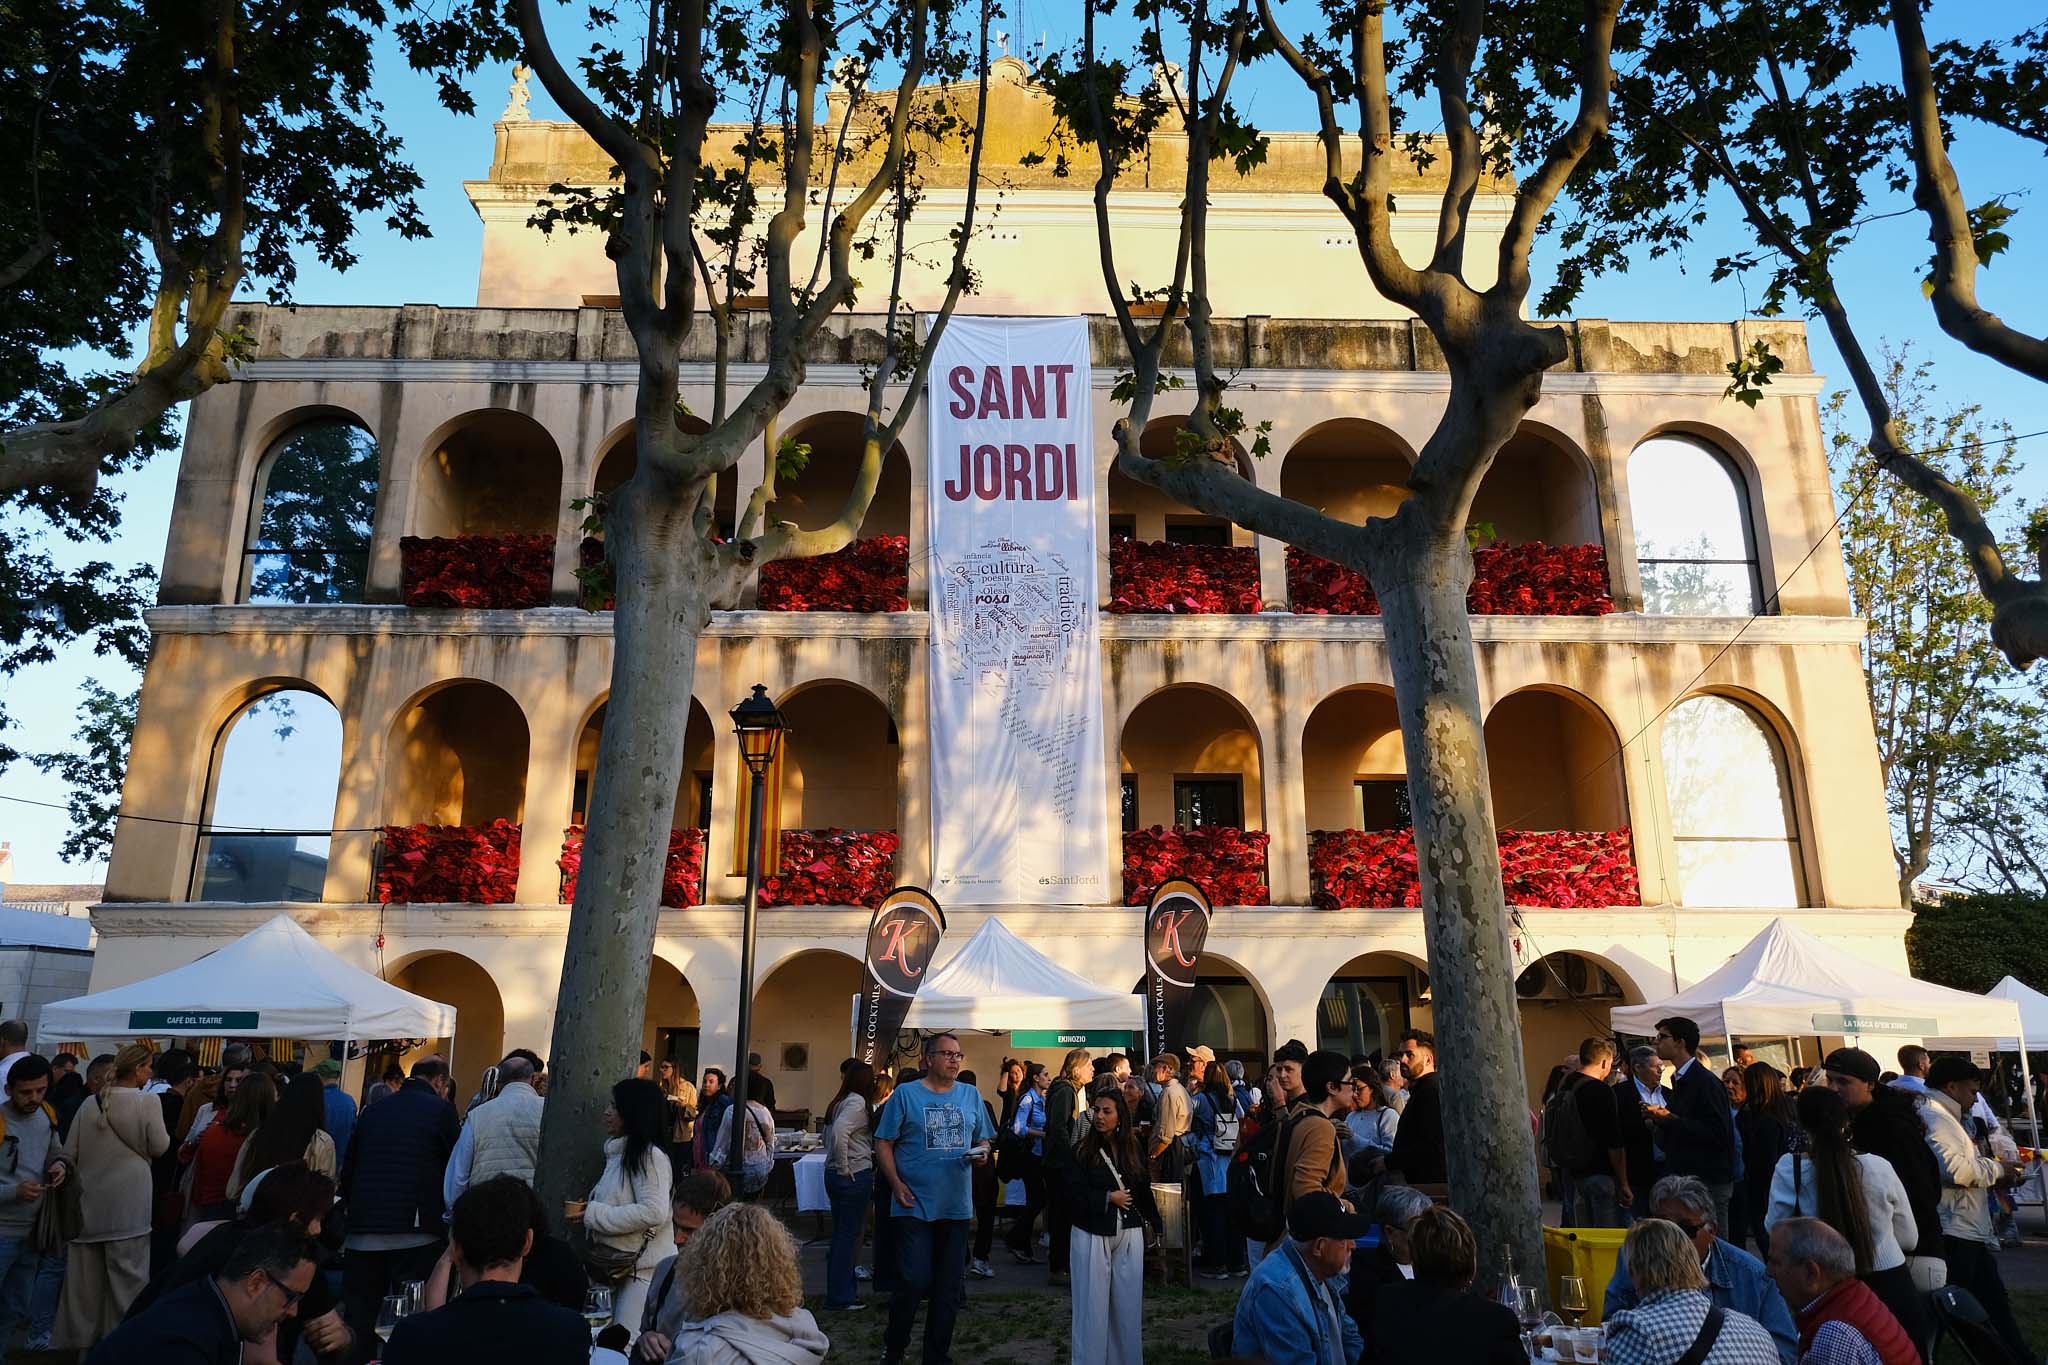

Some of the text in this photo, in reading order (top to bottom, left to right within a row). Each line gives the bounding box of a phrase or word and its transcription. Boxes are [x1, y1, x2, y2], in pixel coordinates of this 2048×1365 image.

[948, 364, 1074, 419] SANT
[944, 443, 1078, 501] JORDI
[980, 560, 1035, 575] cultura
[975, 594, 1010, 605] rosa
[1059, 576, 1075, 633] tradició
[879, 918, 926, 977] K
[1155, 909, 1196, 968] K
[167, 1016, 184, 1024] CAFÉ
[185, 1016, 198, 1024] DEL
[866, 984, 881, 1040] COCKTAILS
[1156, 977, 1165, 1032] COCKTAILS
